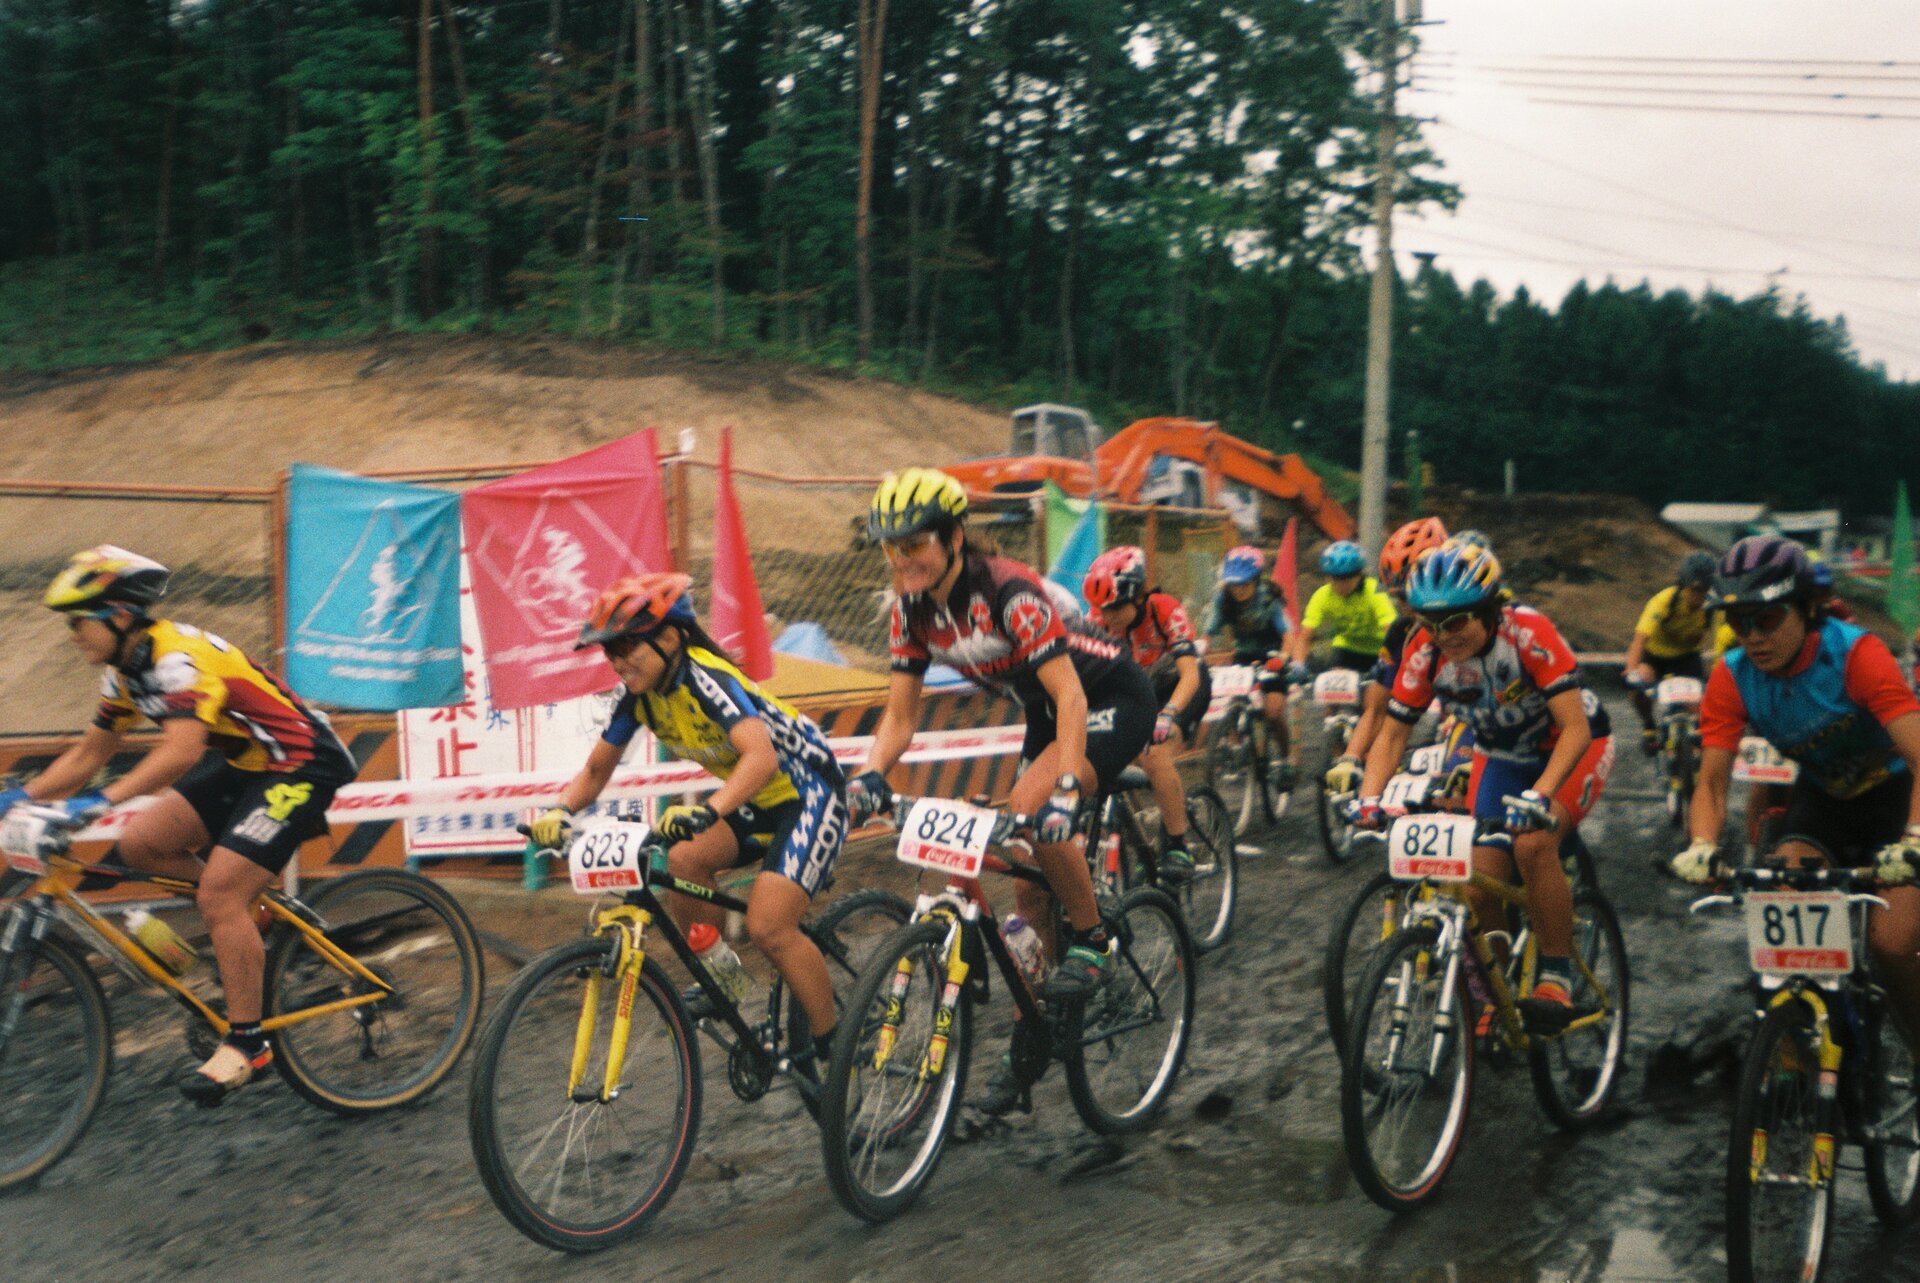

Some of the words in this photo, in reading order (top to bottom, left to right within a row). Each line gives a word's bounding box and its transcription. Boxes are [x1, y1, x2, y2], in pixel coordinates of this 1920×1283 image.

[331, 792, 412, 812] IOGA
[801, 791, 846, 893] SCOTT
[918, 808, 977, 849] 824
[1403, 822, 1456, 857] 821
[581, 831, 628, 869] 823
[674, 877, 714, 899] SCOTT
[1763, 903, 1830, 946] 817
